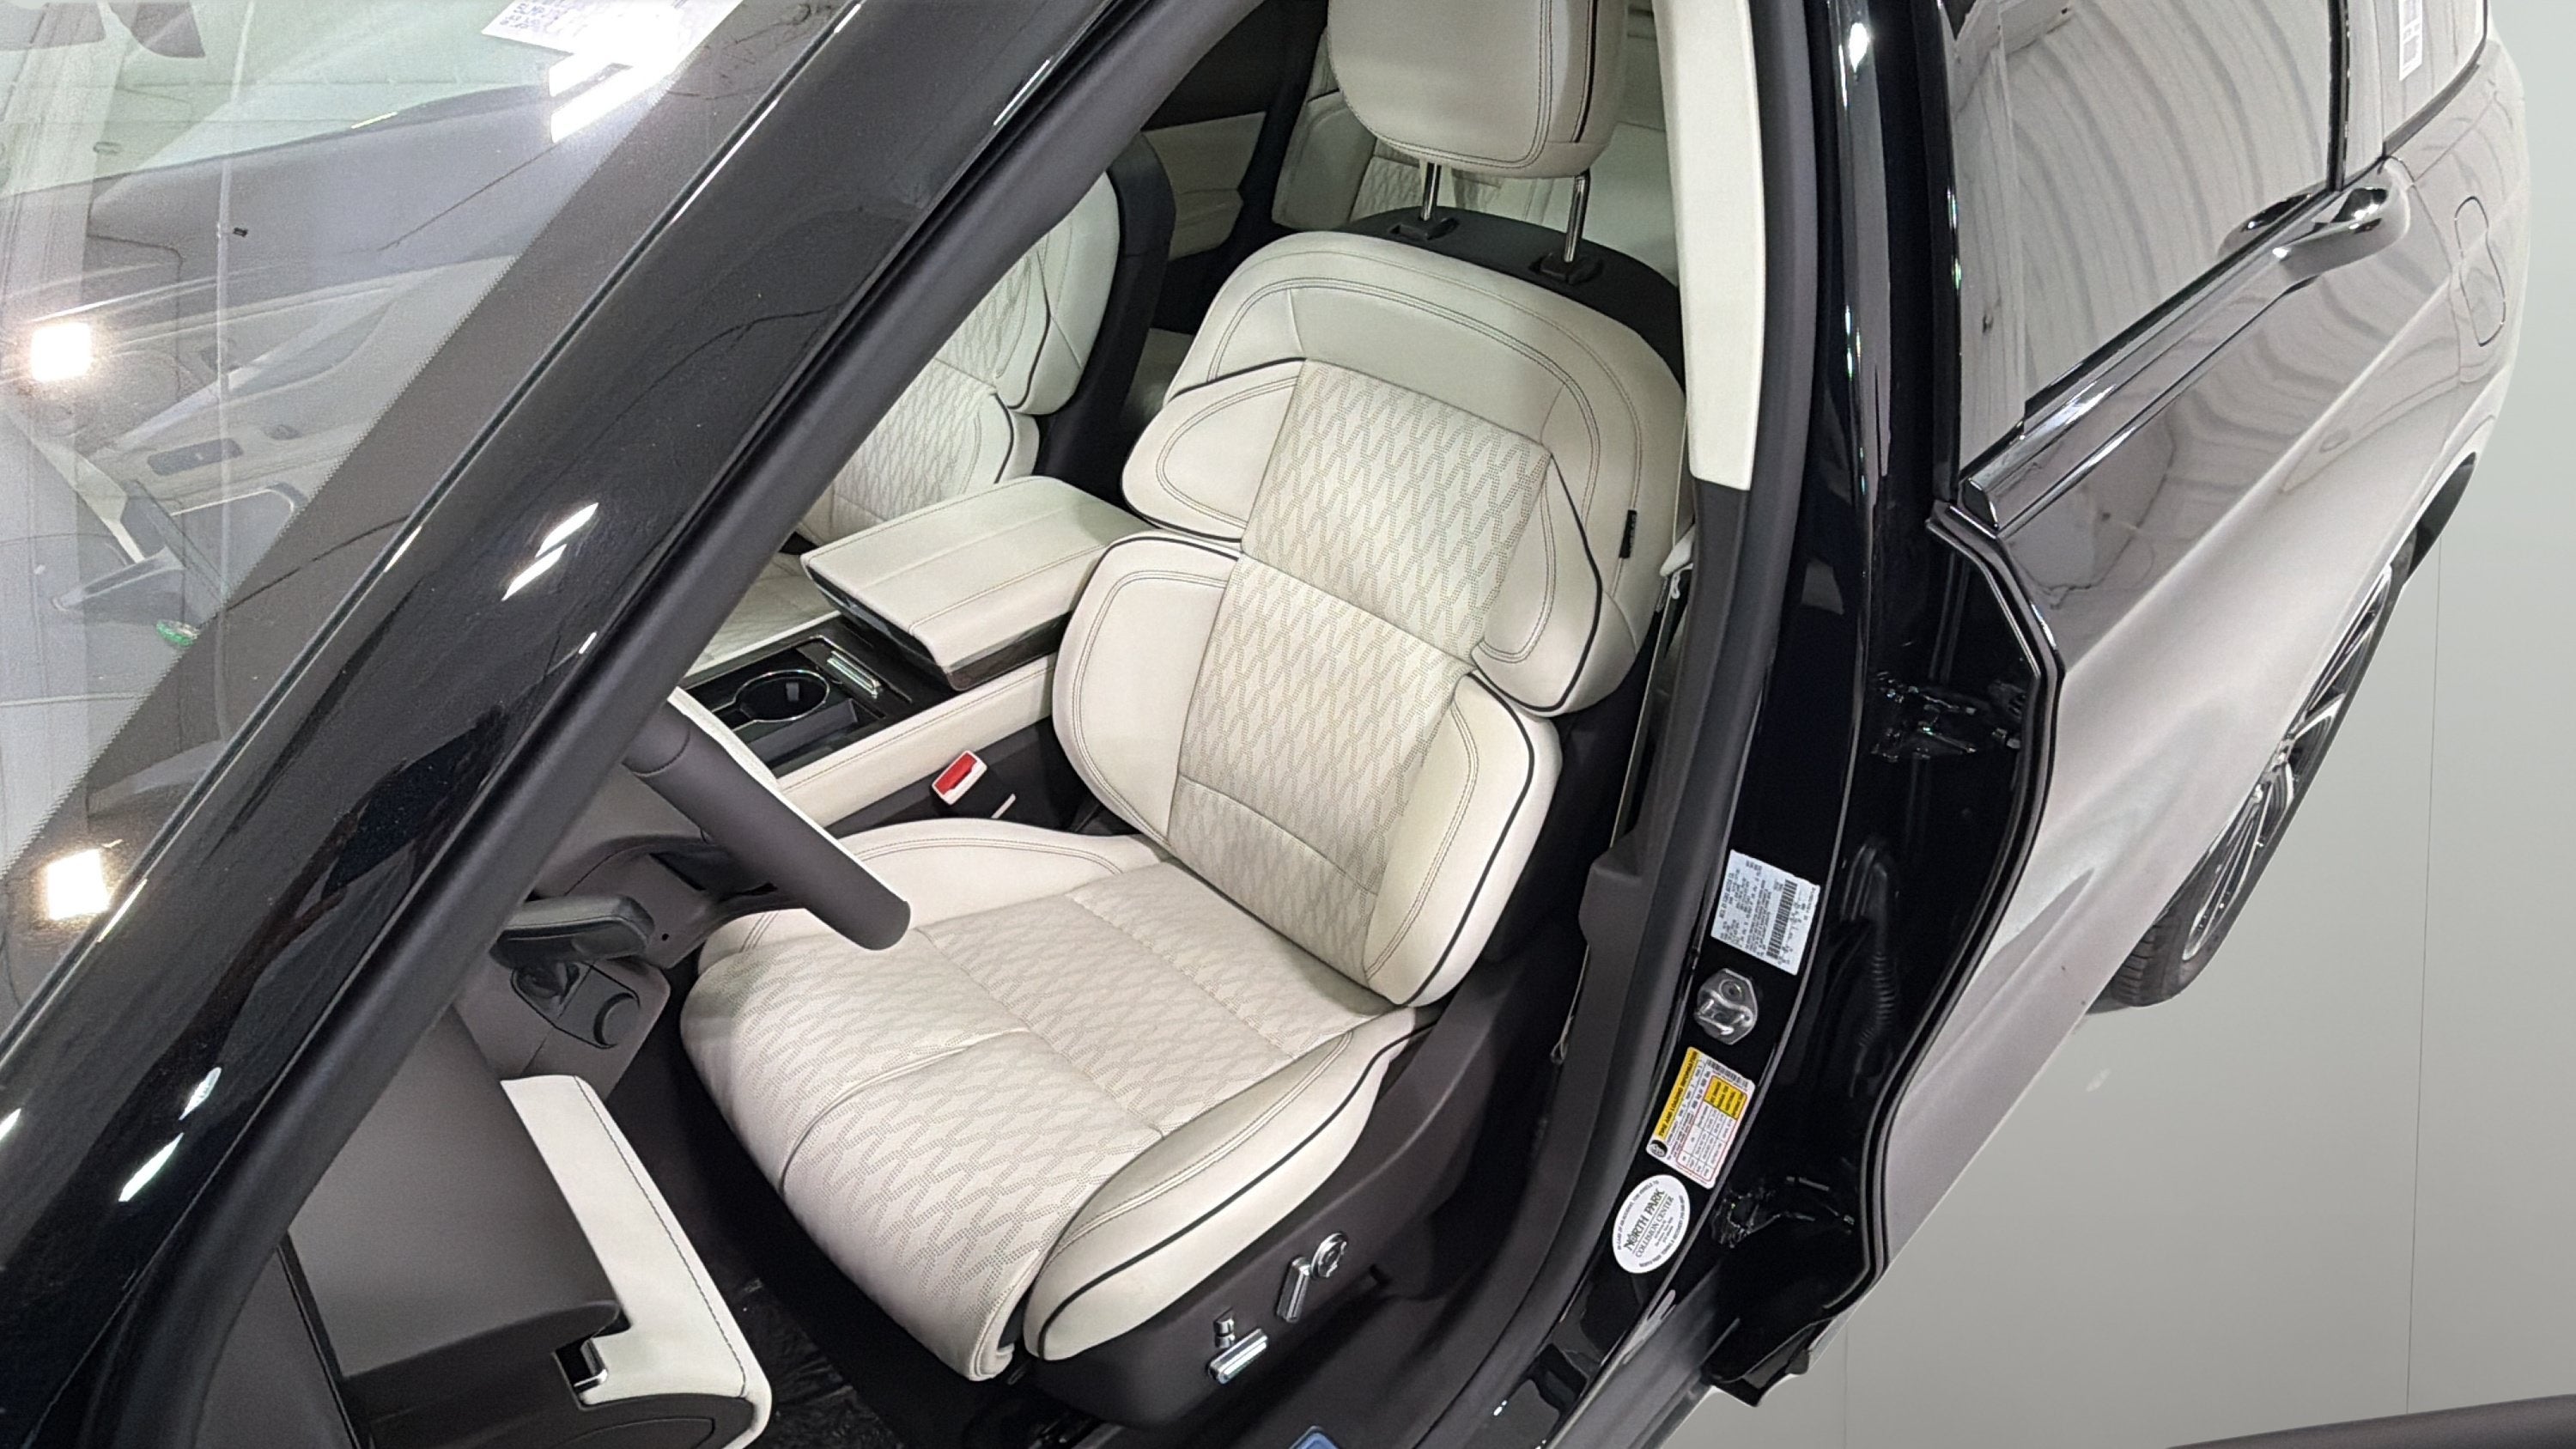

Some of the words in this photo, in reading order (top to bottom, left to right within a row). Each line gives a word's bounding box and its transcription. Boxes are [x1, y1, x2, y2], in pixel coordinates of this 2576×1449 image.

[1623, 1215, 1649, 1251] NORTH
[1643, 1188, 1665, 1216] PARK
[1636, 1222, 1662, 1258] COLLISION
[1656, 1196, 1674, 1223] CENTER
